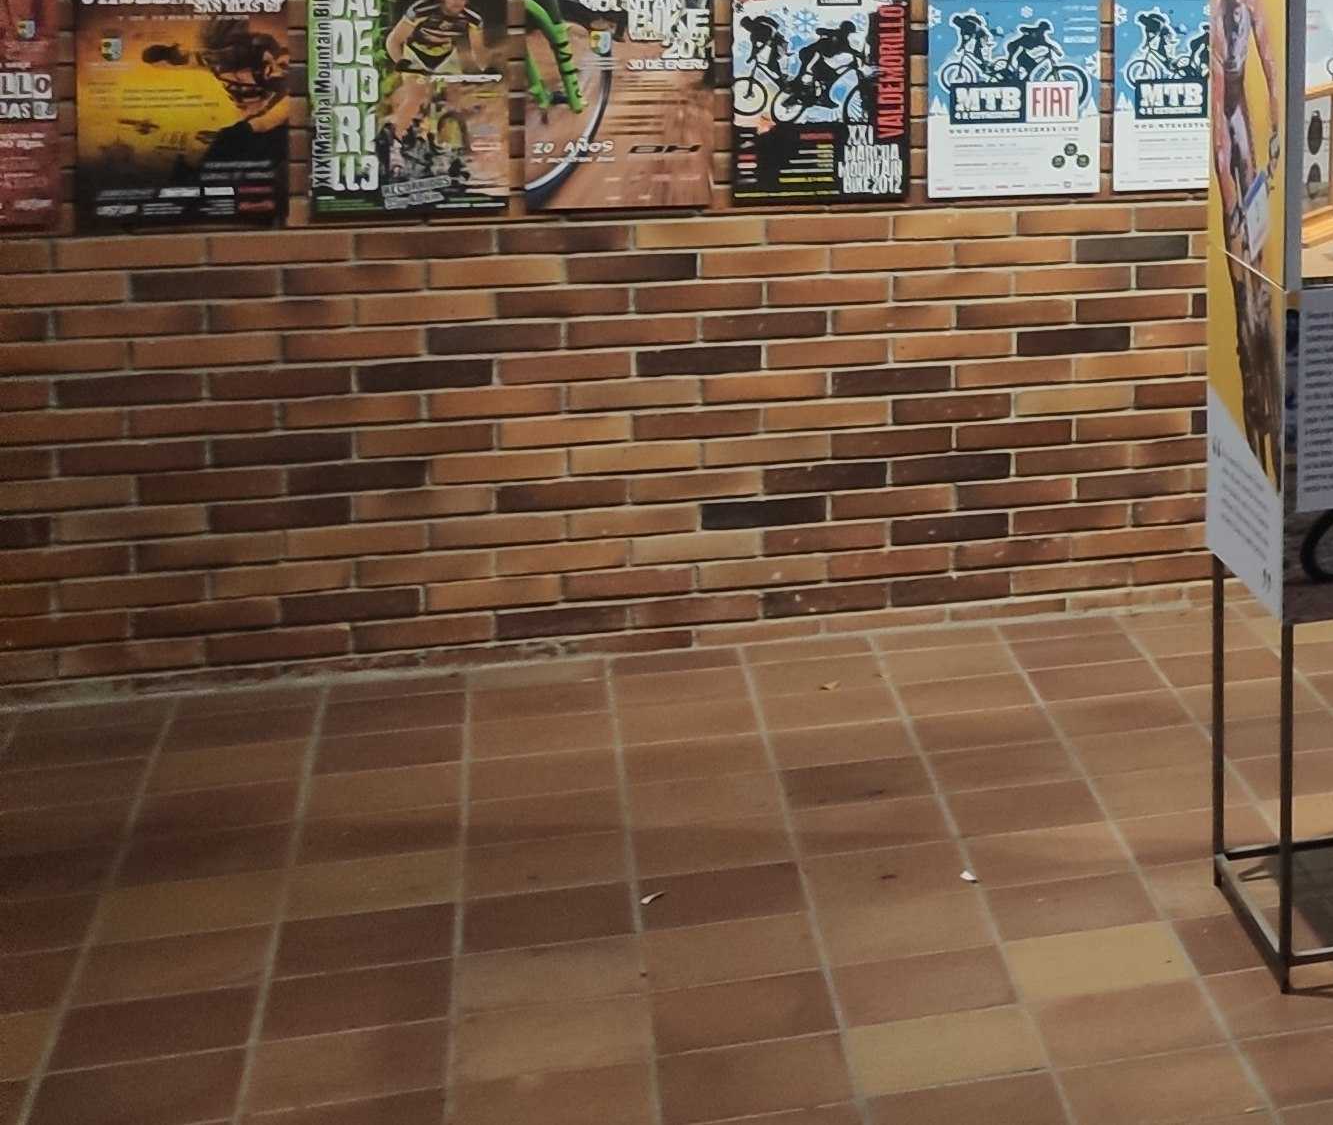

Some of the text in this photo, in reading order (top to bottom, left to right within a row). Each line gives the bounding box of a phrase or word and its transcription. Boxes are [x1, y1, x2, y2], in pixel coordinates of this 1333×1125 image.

[628, 8, 711, 42] BIKE
[313, 21, 332, 94] Mountain
[332, 19, 374, 66] DE
[876, 6, 905, 138] VALDEMORILLO
[955, 86, 1074, 118] MTB FIAT
[1140, 83, 1204, 108] MTB
[313, 97, 332, 156] Marcha
[847, 124, 874, 146] XXI
[843, 143, 900, 162] MARCHA
[313, 157, 332, 186] XIX
[837, 160, 904, 178] MOUNTAIN
